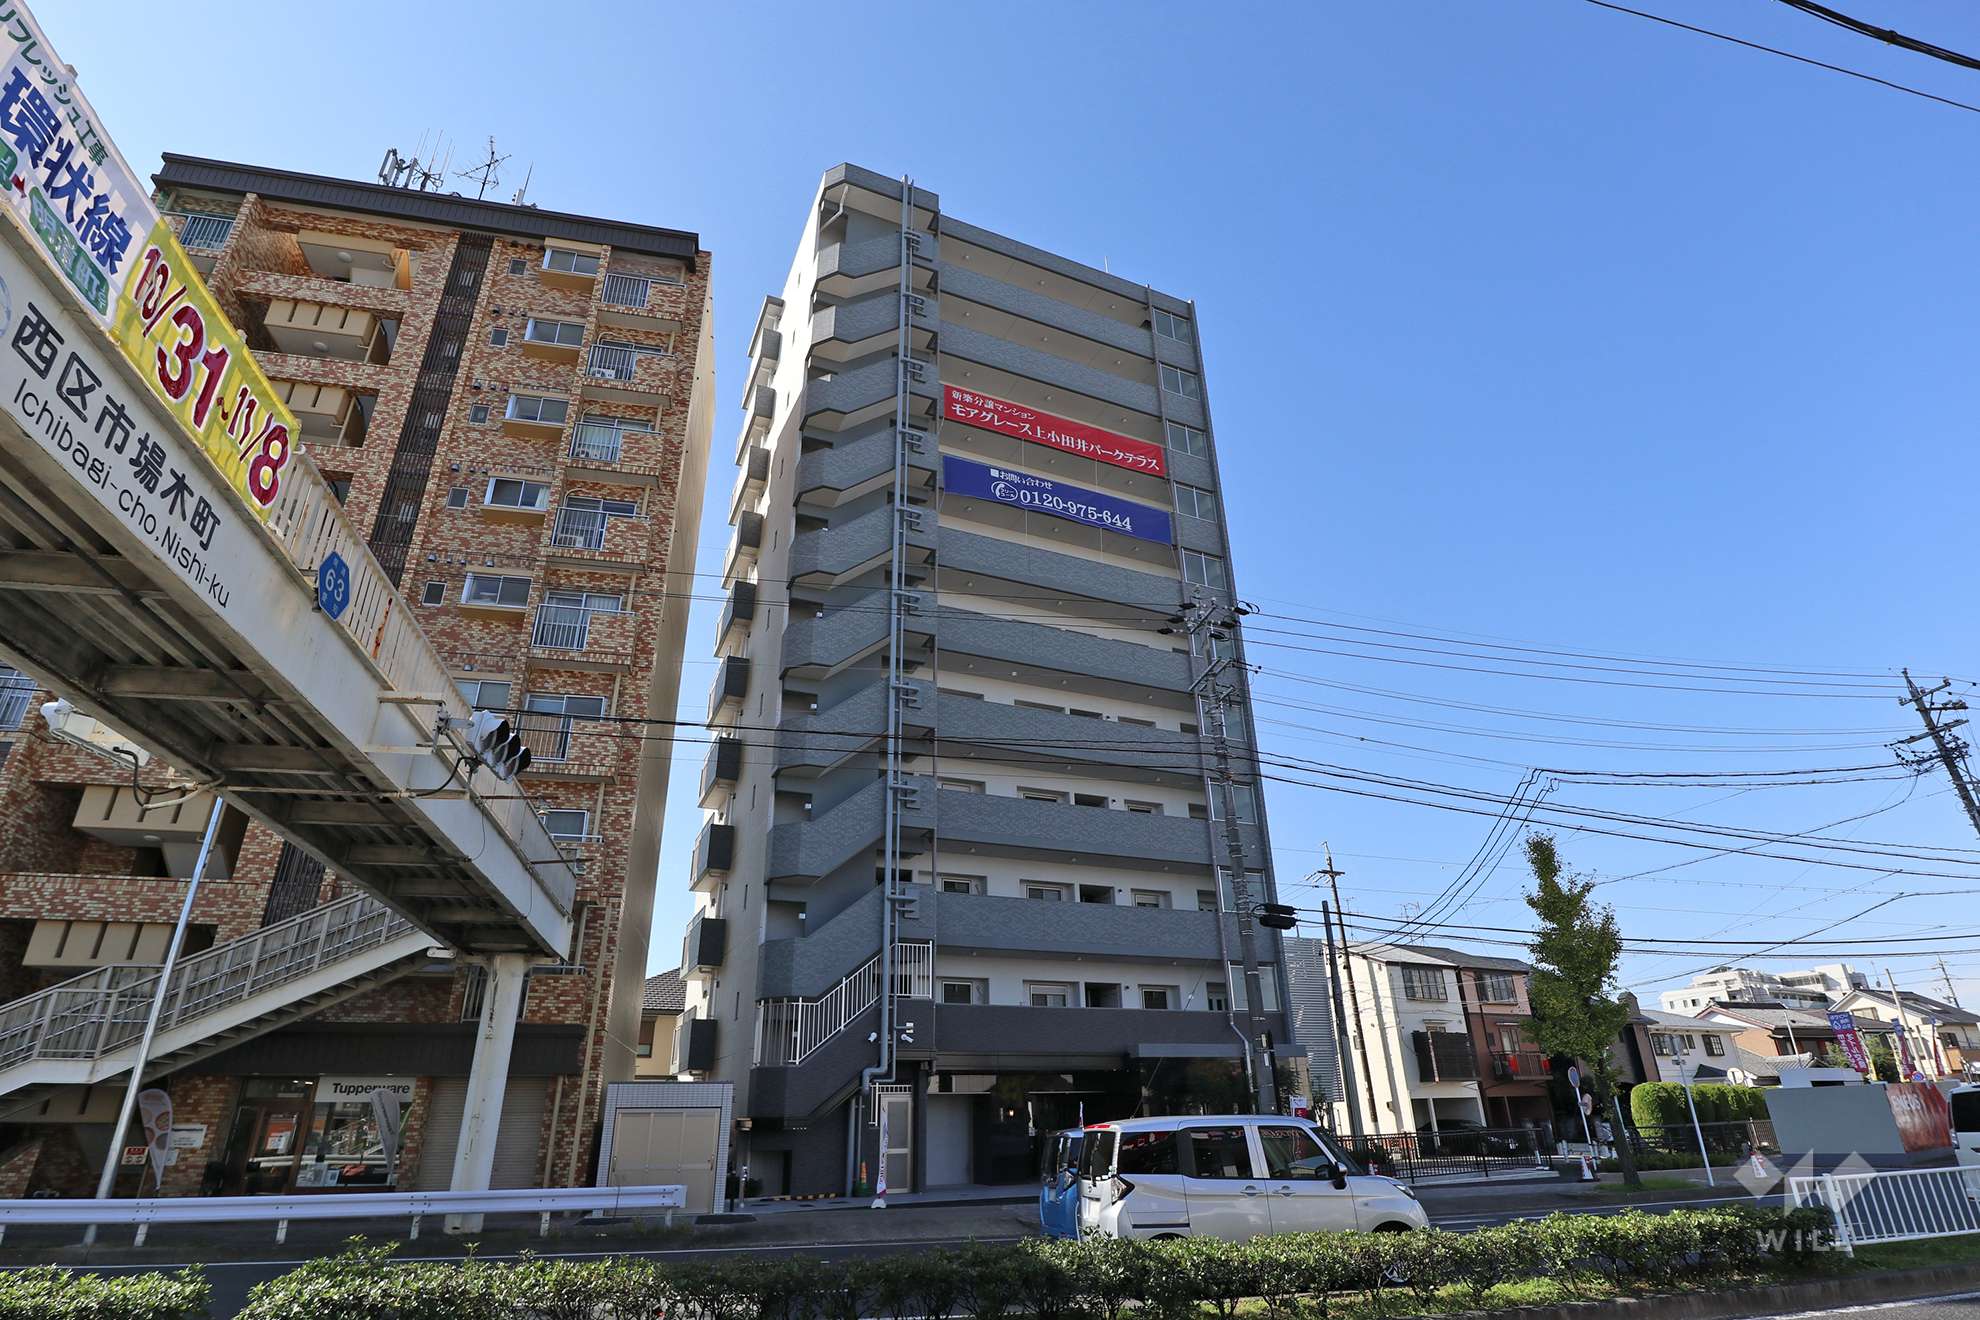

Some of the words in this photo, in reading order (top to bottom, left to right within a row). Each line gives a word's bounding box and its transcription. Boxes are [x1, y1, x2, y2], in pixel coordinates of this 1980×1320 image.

[0, 66, 133, 276] 環状線
[11, 302, 222, 551] 西区市場木町
[951, 403, 1160, 471] モアグレース上小田井パークテラス
[1020, 489, 1133, 531] 0120-975-644
[325, 569, 345, 602] 63
